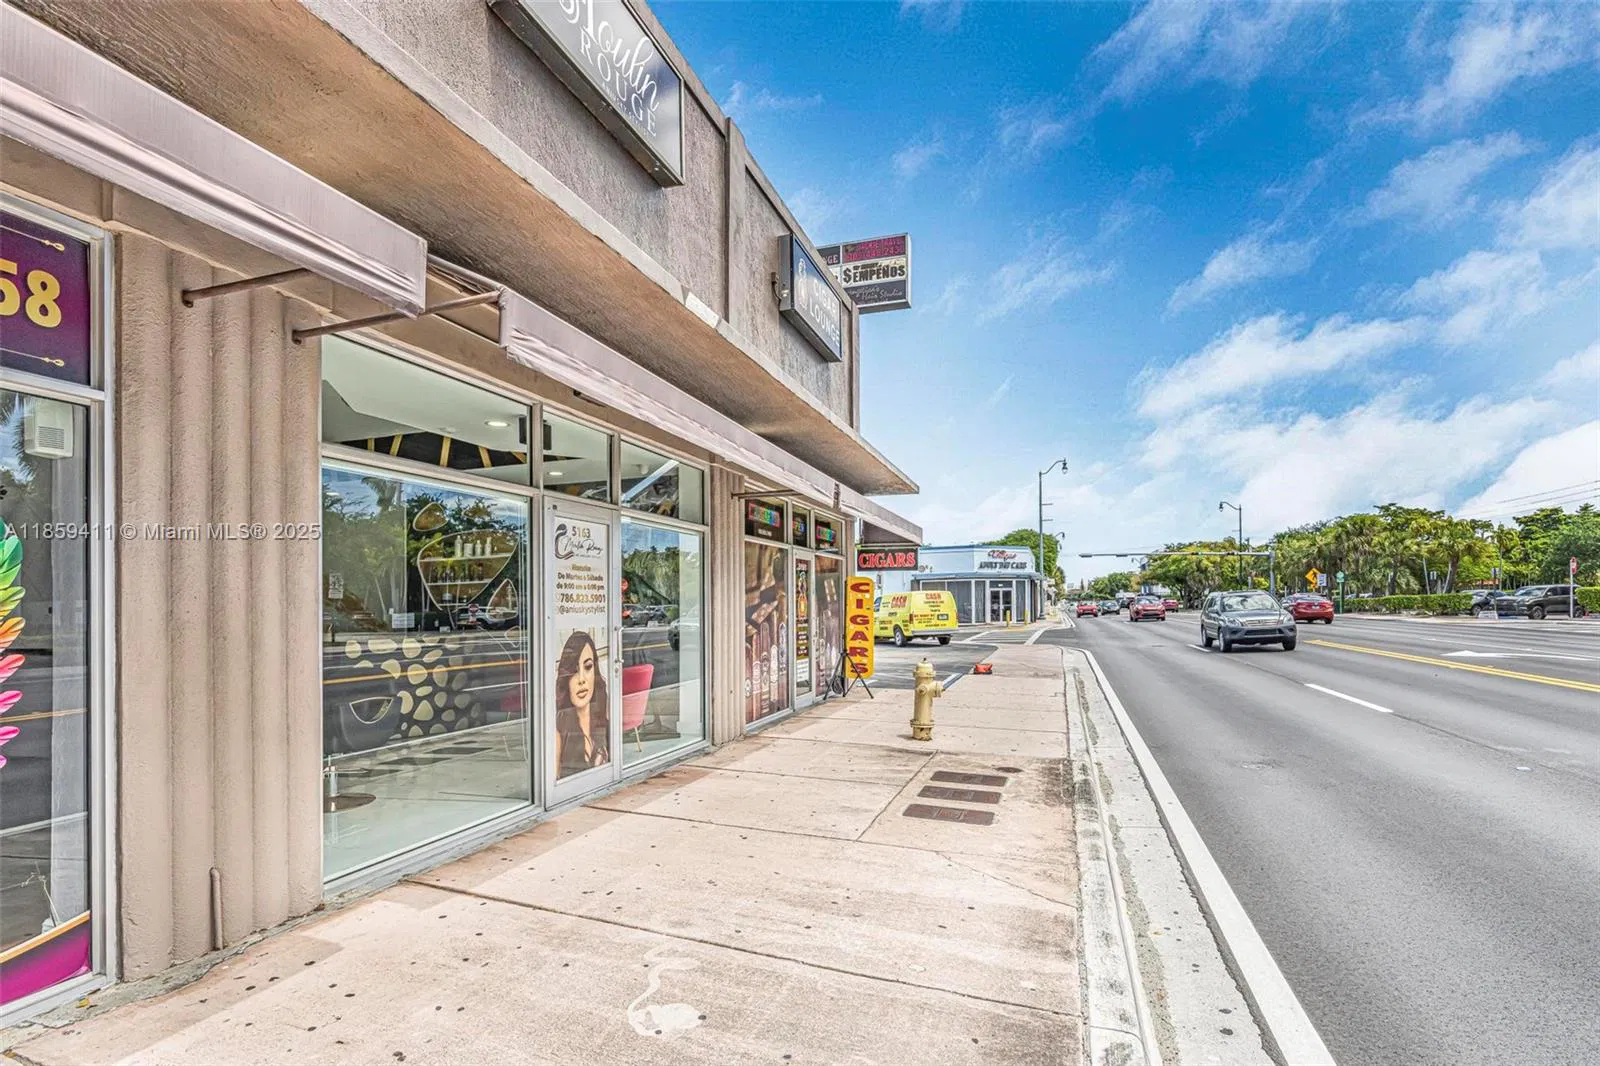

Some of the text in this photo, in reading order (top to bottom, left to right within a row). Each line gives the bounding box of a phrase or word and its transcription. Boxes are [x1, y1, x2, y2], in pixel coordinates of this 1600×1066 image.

[580, 27, 656, 137] ROUGE
[858, 551, 916, 569] CIGARS
[850, 582, 871, 674] CIGARS
